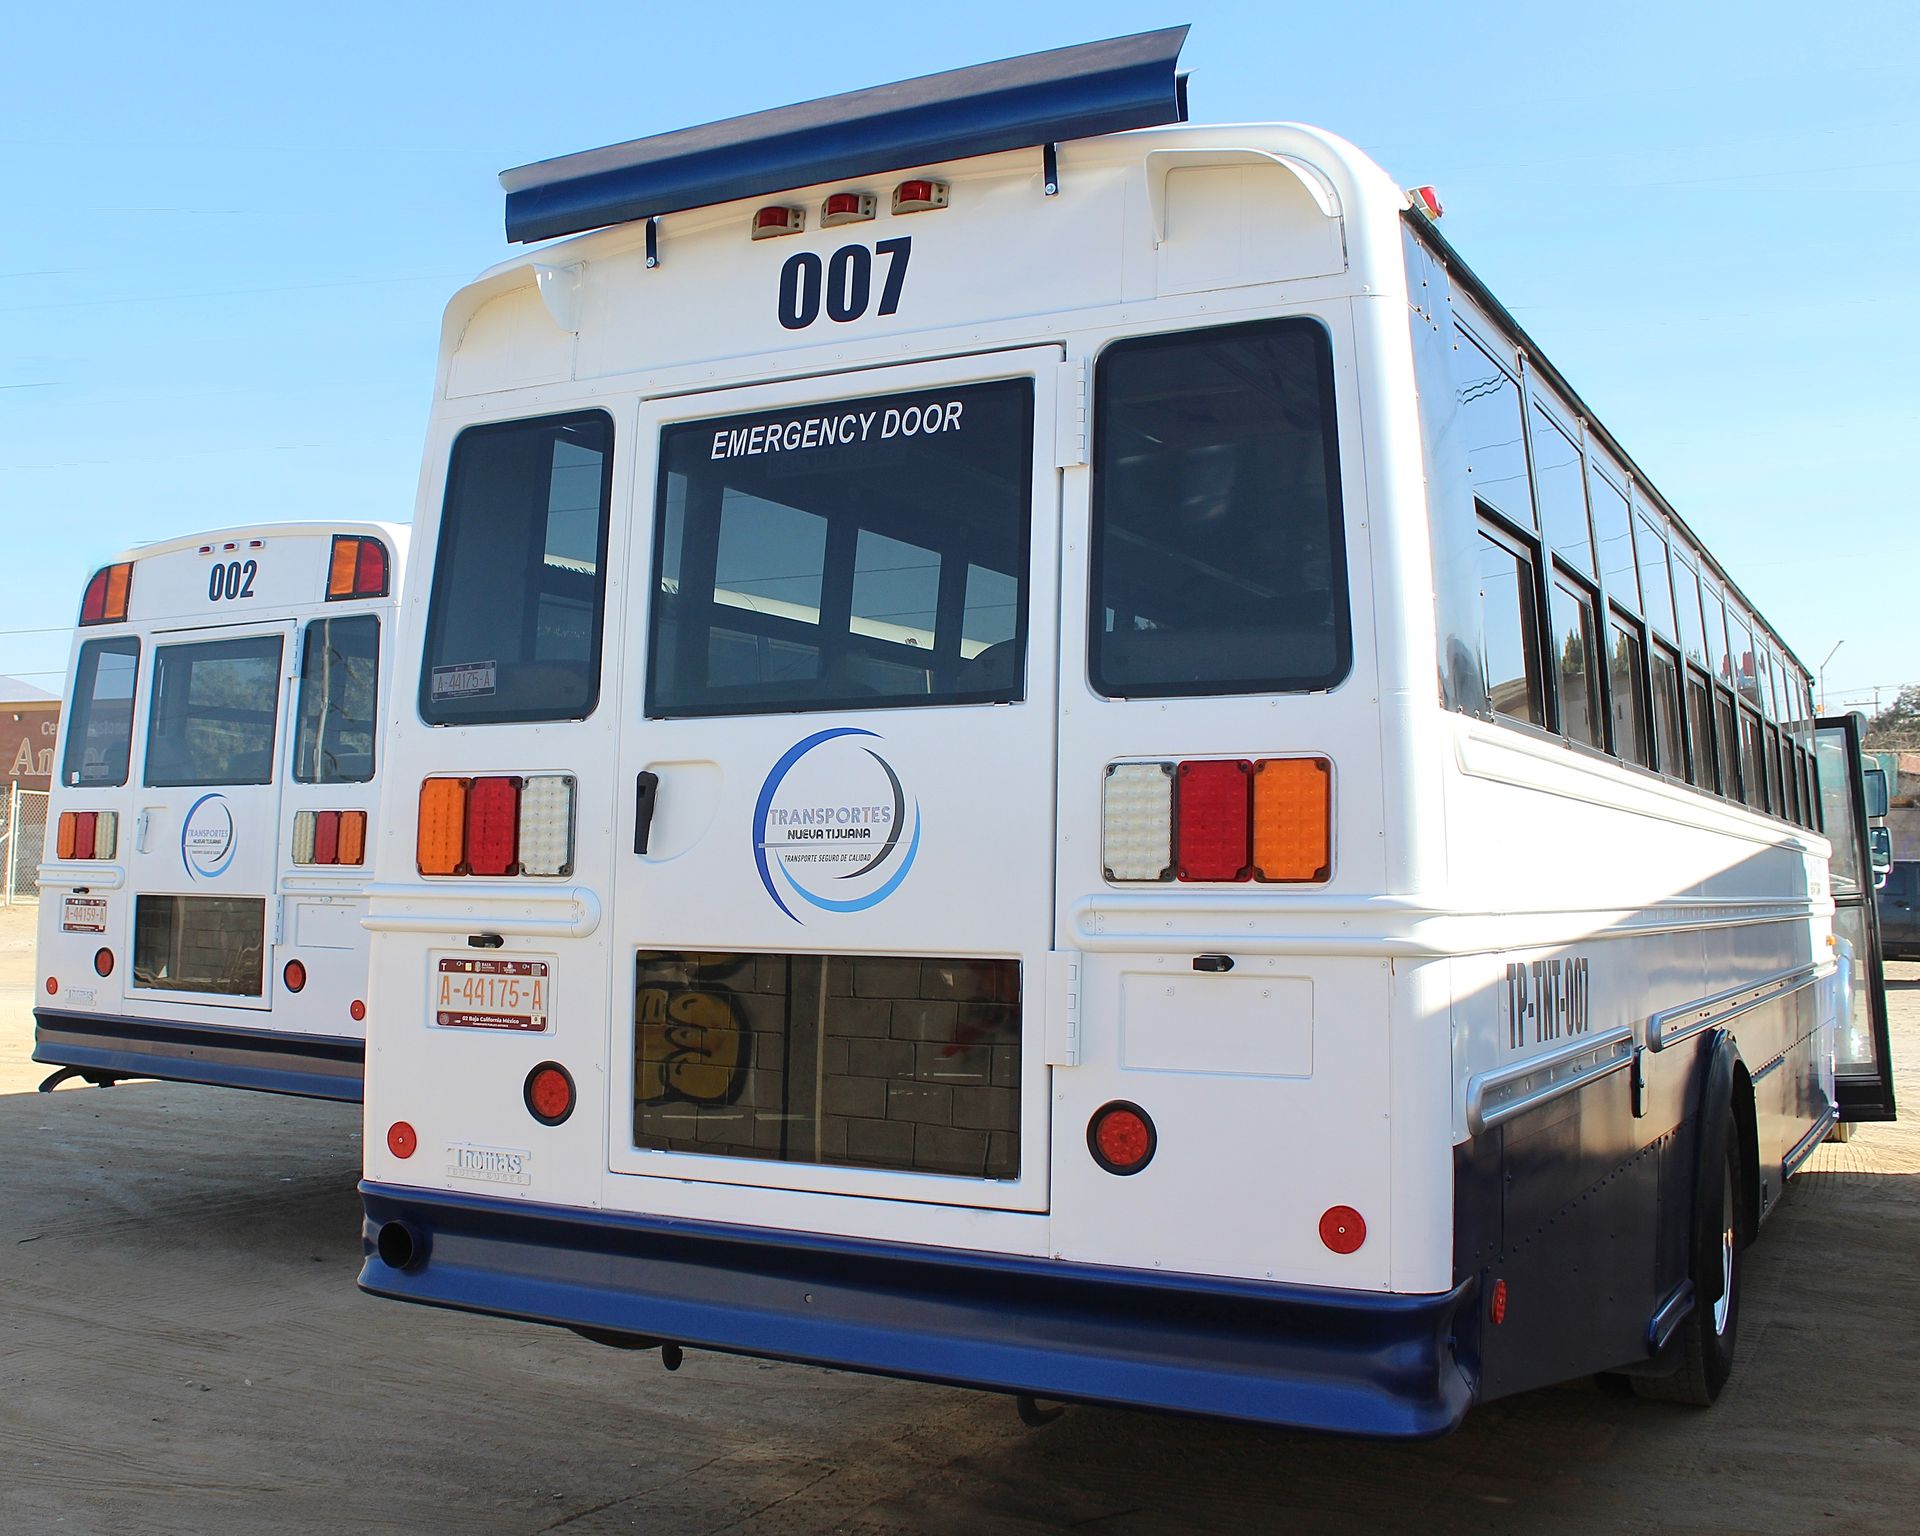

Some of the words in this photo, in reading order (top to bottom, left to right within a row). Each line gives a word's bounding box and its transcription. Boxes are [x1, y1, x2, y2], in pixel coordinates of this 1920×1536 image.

[778, 236, 912, 330] 007
[711, 411, 877, 460] EMERGENCY
[881, 401, 963, 439] DOOR
[209, 560, 257, 601] 002
[438, 671, 490, 692] A-44175-A
[41, 721, 58, 735] Ce
[769, 806, 891, 825] TRANSPORTES
[787, 829, 824, 840] NUEVA
[825, 828, 871, 839] TIJUANA
[784, 854, 818, 862] TRANSPORTE
[818, 854, 839, 862] SEGURO
[840, 854, 848, 862] DE
[848, 854, 872, 862] CALIDAD
[440, 975, 542, 1010] A-44175-A
[1506, 957, 1588, 1050] TP-TNT-007
